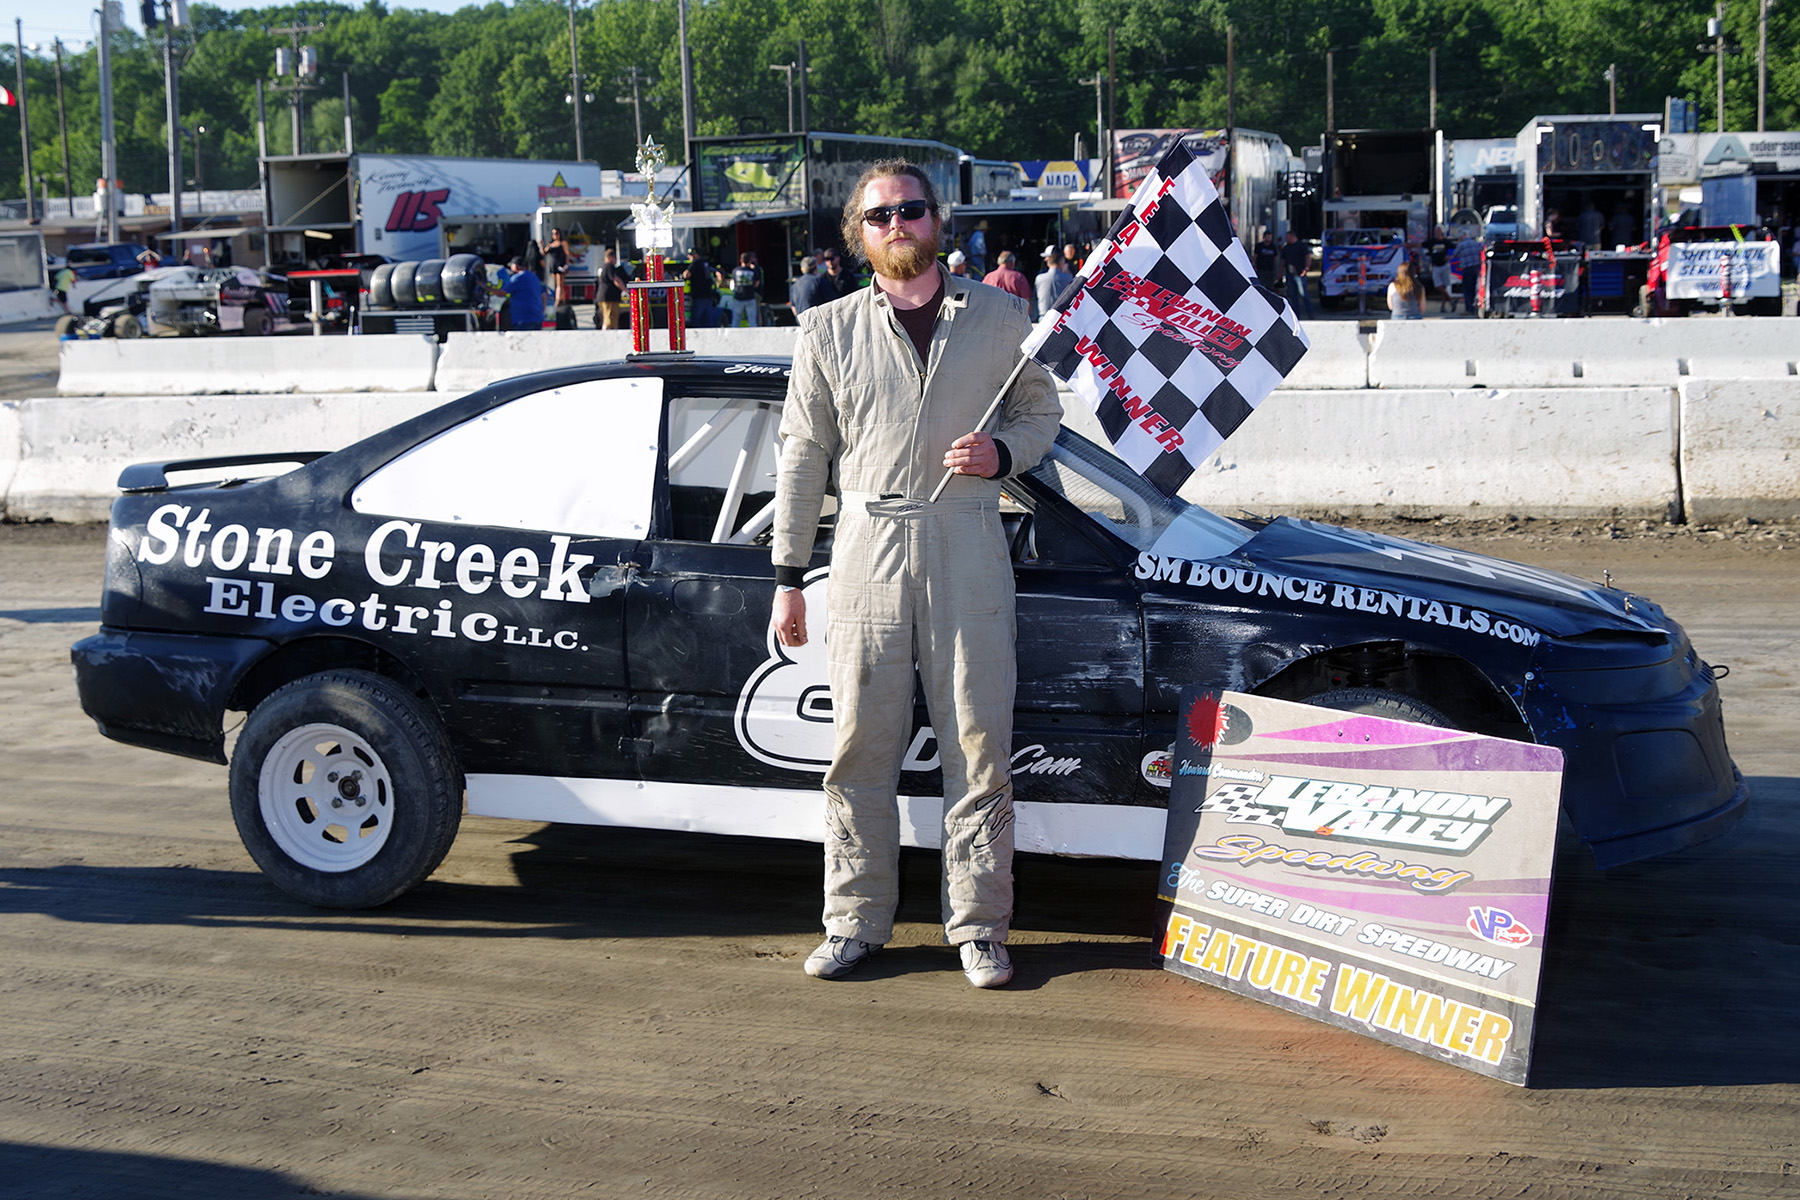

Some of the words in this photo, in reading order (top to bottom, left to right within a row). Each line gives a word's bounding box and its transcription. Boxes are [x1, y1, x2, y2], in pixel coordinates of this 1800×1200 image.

[385, 187, 451, 232] 115
[1046, 173, 1078, 189] NAPA
[1137, 278, 1252, 337] LEBANON
[1146, 300, 1245, 351] VALLEY
[724, 363, 781, 375] Steve
[1120, 312, 1242, 369] Speedway
[1075, 335, 1185, 454] WINNER
[137, 503, 335, 580] Stone
[364, 520, 596, 604] Creek
[204, 576, 499, 643] Electric
[1134, 551, 1186, 584] SM
[1186, 561, 1326, 604] BOUNCE
[1331, 585, 1541, 647] RENTALS.COM
[1010, 744, 1082, 776] Cam
[1256, 775, 1512, 824] LEBANON
[1279, 803, 1493, 856] VALLEY
[1195, 835, 1474, 896] Speedway
[1166, 862, 1205, 895] The
[1206, 879, 1288, 919] SUPER
[1288, 902, 1359, 937] DIRT
[1357, 922, 1516, 981] SPEEDWAY
[1470, 907, 1514, 941] VP
[1161, 912, 1332, 1006] FEATURE
[1330, 962, 1513, 1066] WINNER
